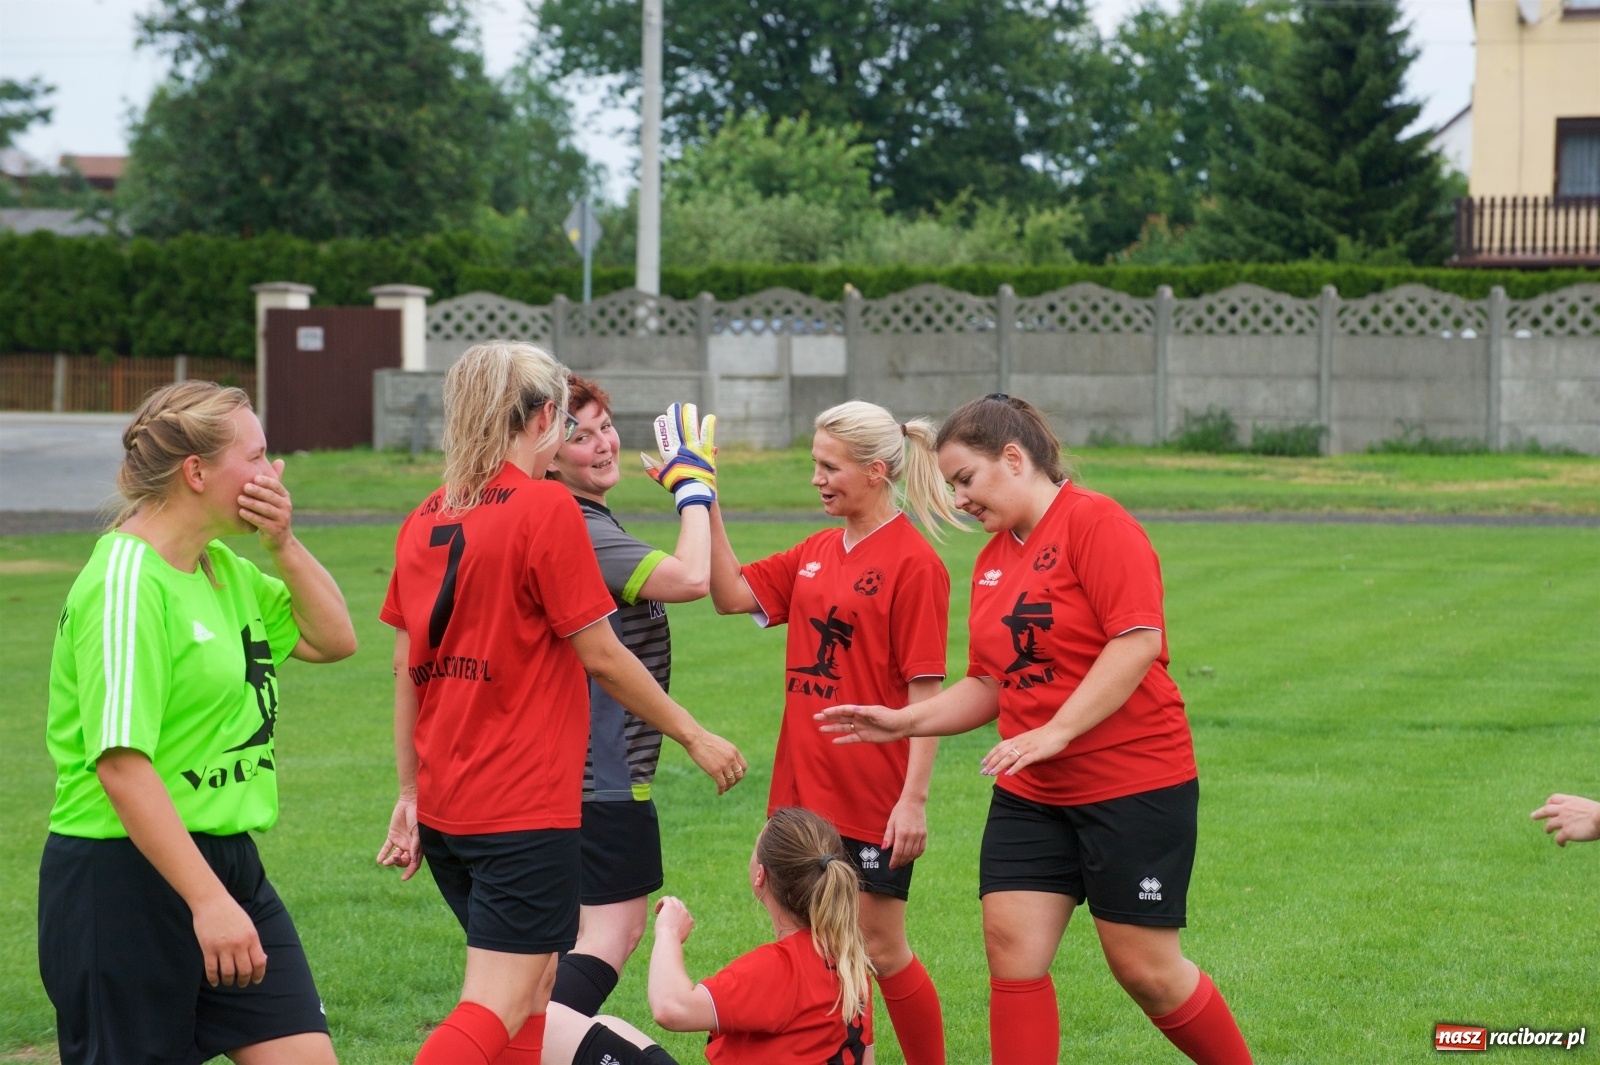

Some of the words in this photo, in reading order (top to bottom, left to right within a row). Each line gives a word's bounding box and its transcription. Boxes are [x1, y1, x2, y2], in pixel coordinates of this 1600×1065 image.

[656, 416, 670, 452] reusch
[429, 523, 466, 649] 7
[787, 676, 839, 702] BANK
[1138, 891, 1162, 901] errea
